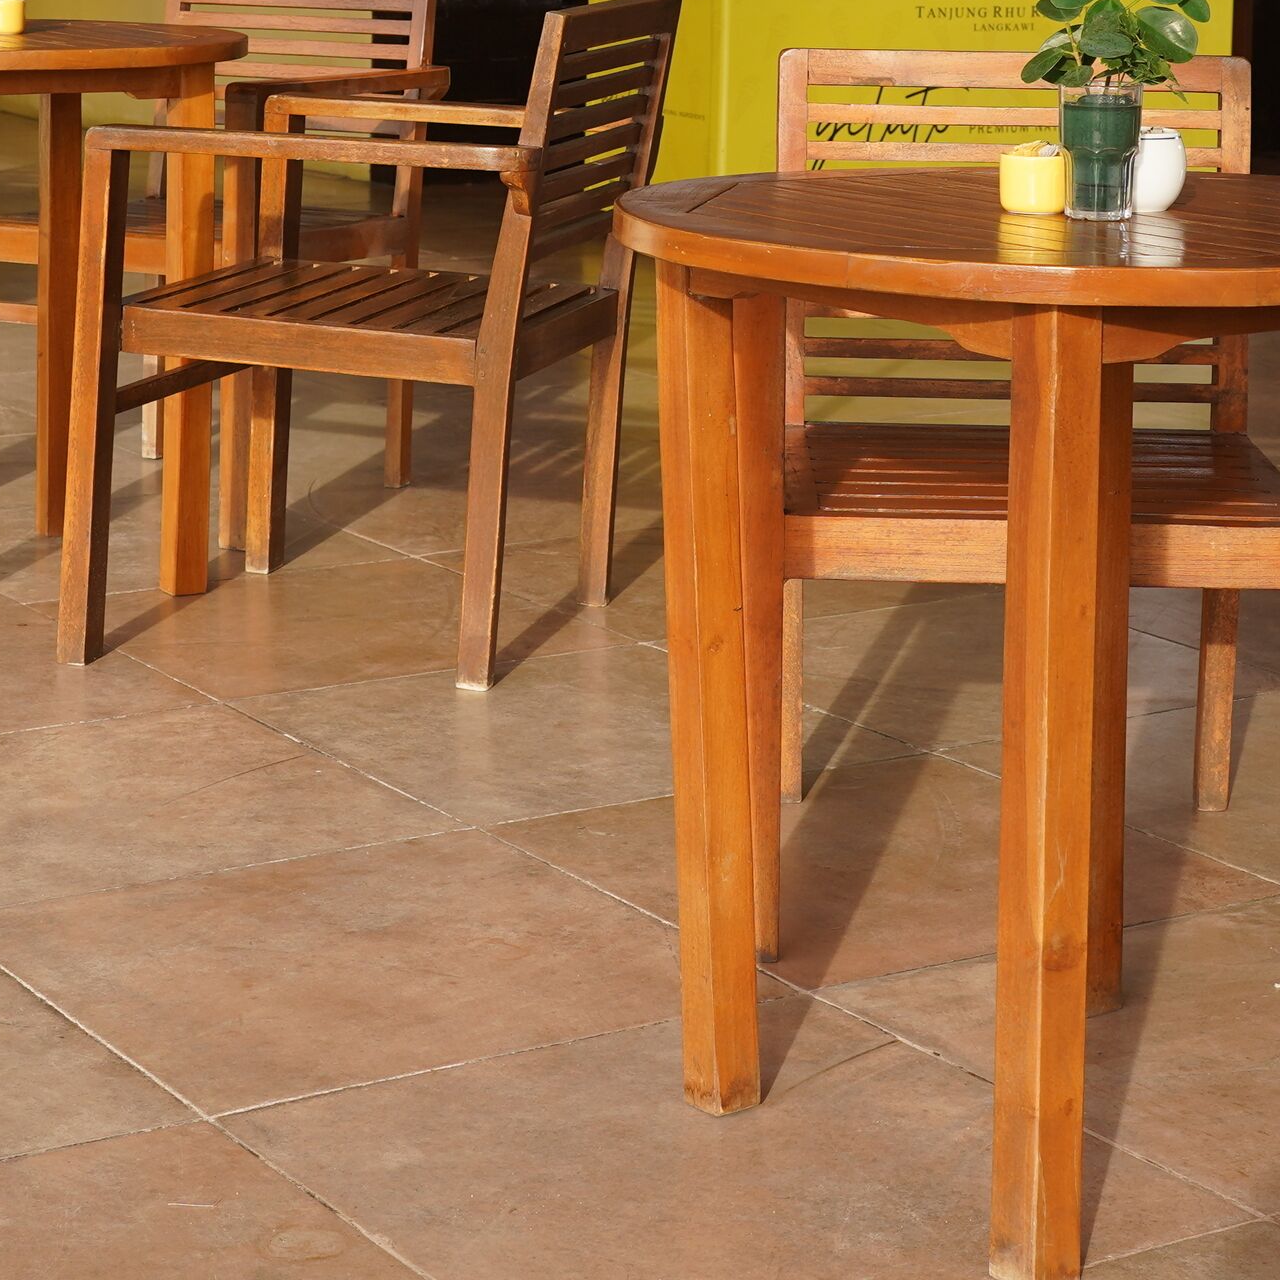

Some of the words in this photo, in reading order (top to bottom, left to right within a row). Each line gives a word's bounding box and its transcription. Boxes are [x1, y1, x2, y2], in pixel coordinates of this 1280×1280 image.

[915, 5, 988, 20] TANJUNG
[993, 5, 1026, 18] RHU
[973, 23, 1035, 32] LANGKAWI
